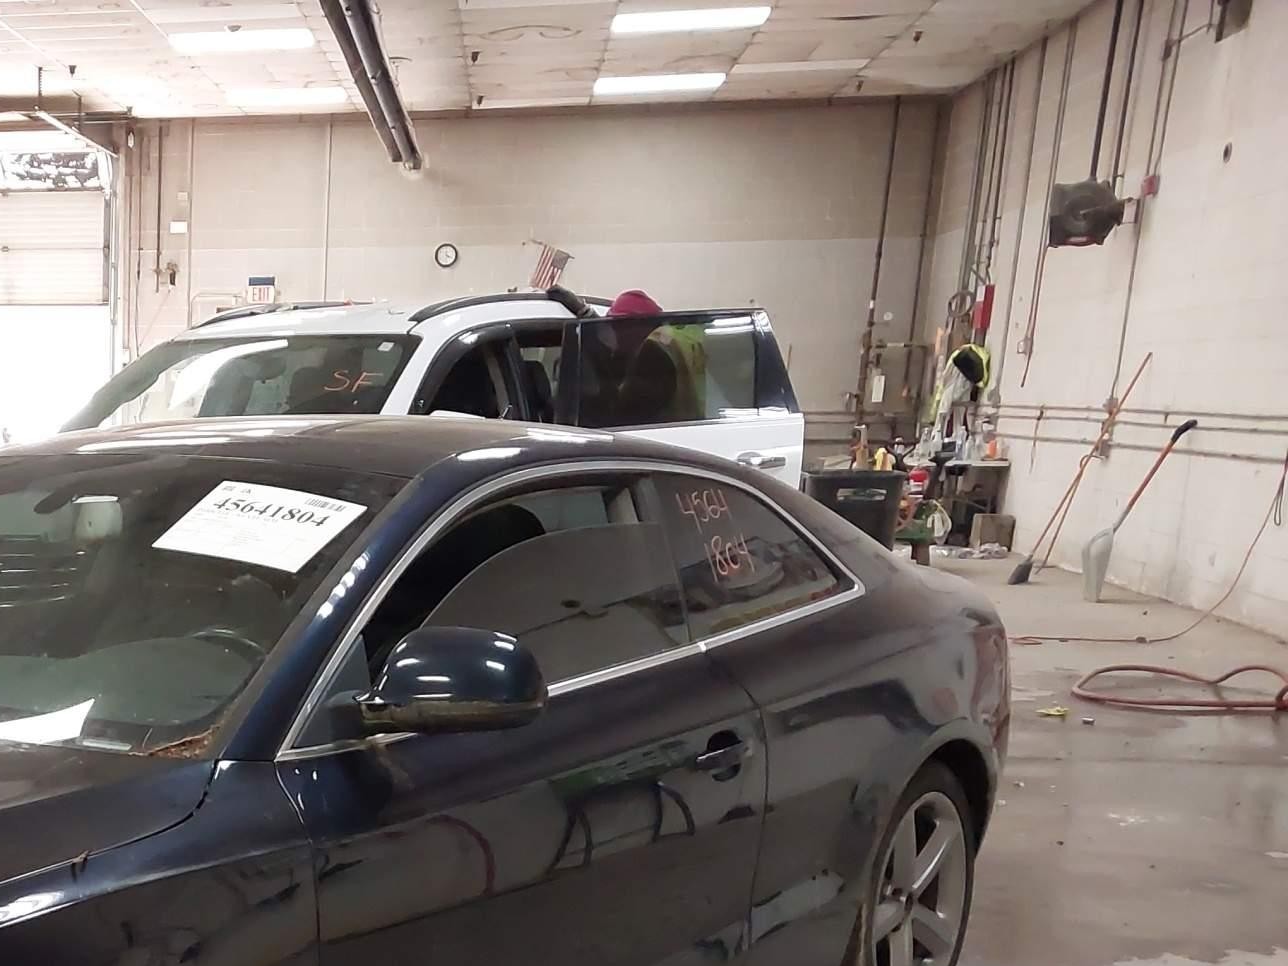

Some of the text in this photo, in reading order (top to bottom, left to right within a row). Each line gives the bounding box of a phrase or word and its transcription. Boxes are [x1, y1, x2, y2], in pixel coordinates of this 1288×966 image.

[252, 287, 271, 302] EXIT
[324, 369, 384, 393] SF
[213, 497, 330, 527] 45641804
[675, 488, 732, 534] 4564
[704, 533, 755, 584] 1804
